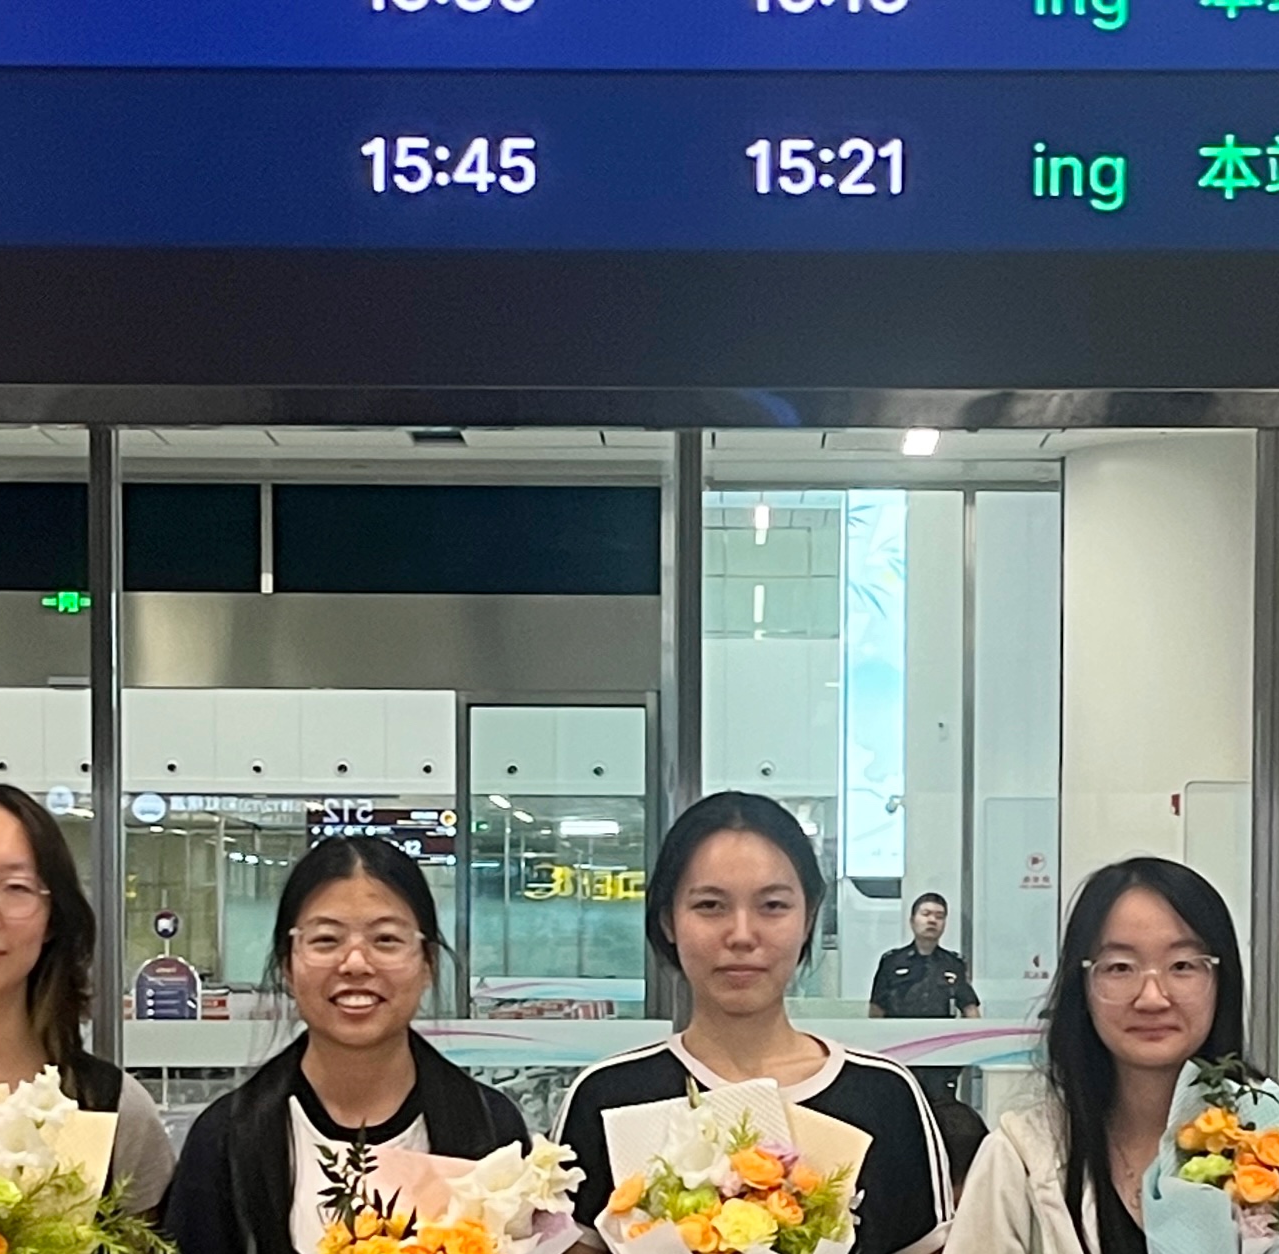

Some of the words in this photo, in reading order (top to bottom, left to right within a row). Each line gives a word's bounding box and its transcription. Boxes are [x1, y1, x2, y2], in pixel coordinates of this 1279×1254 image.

[360, 135, 537, 195] 15:45
[744, 136, 904, 196] 15:21
[1032, 141, 1127, 212] ing
